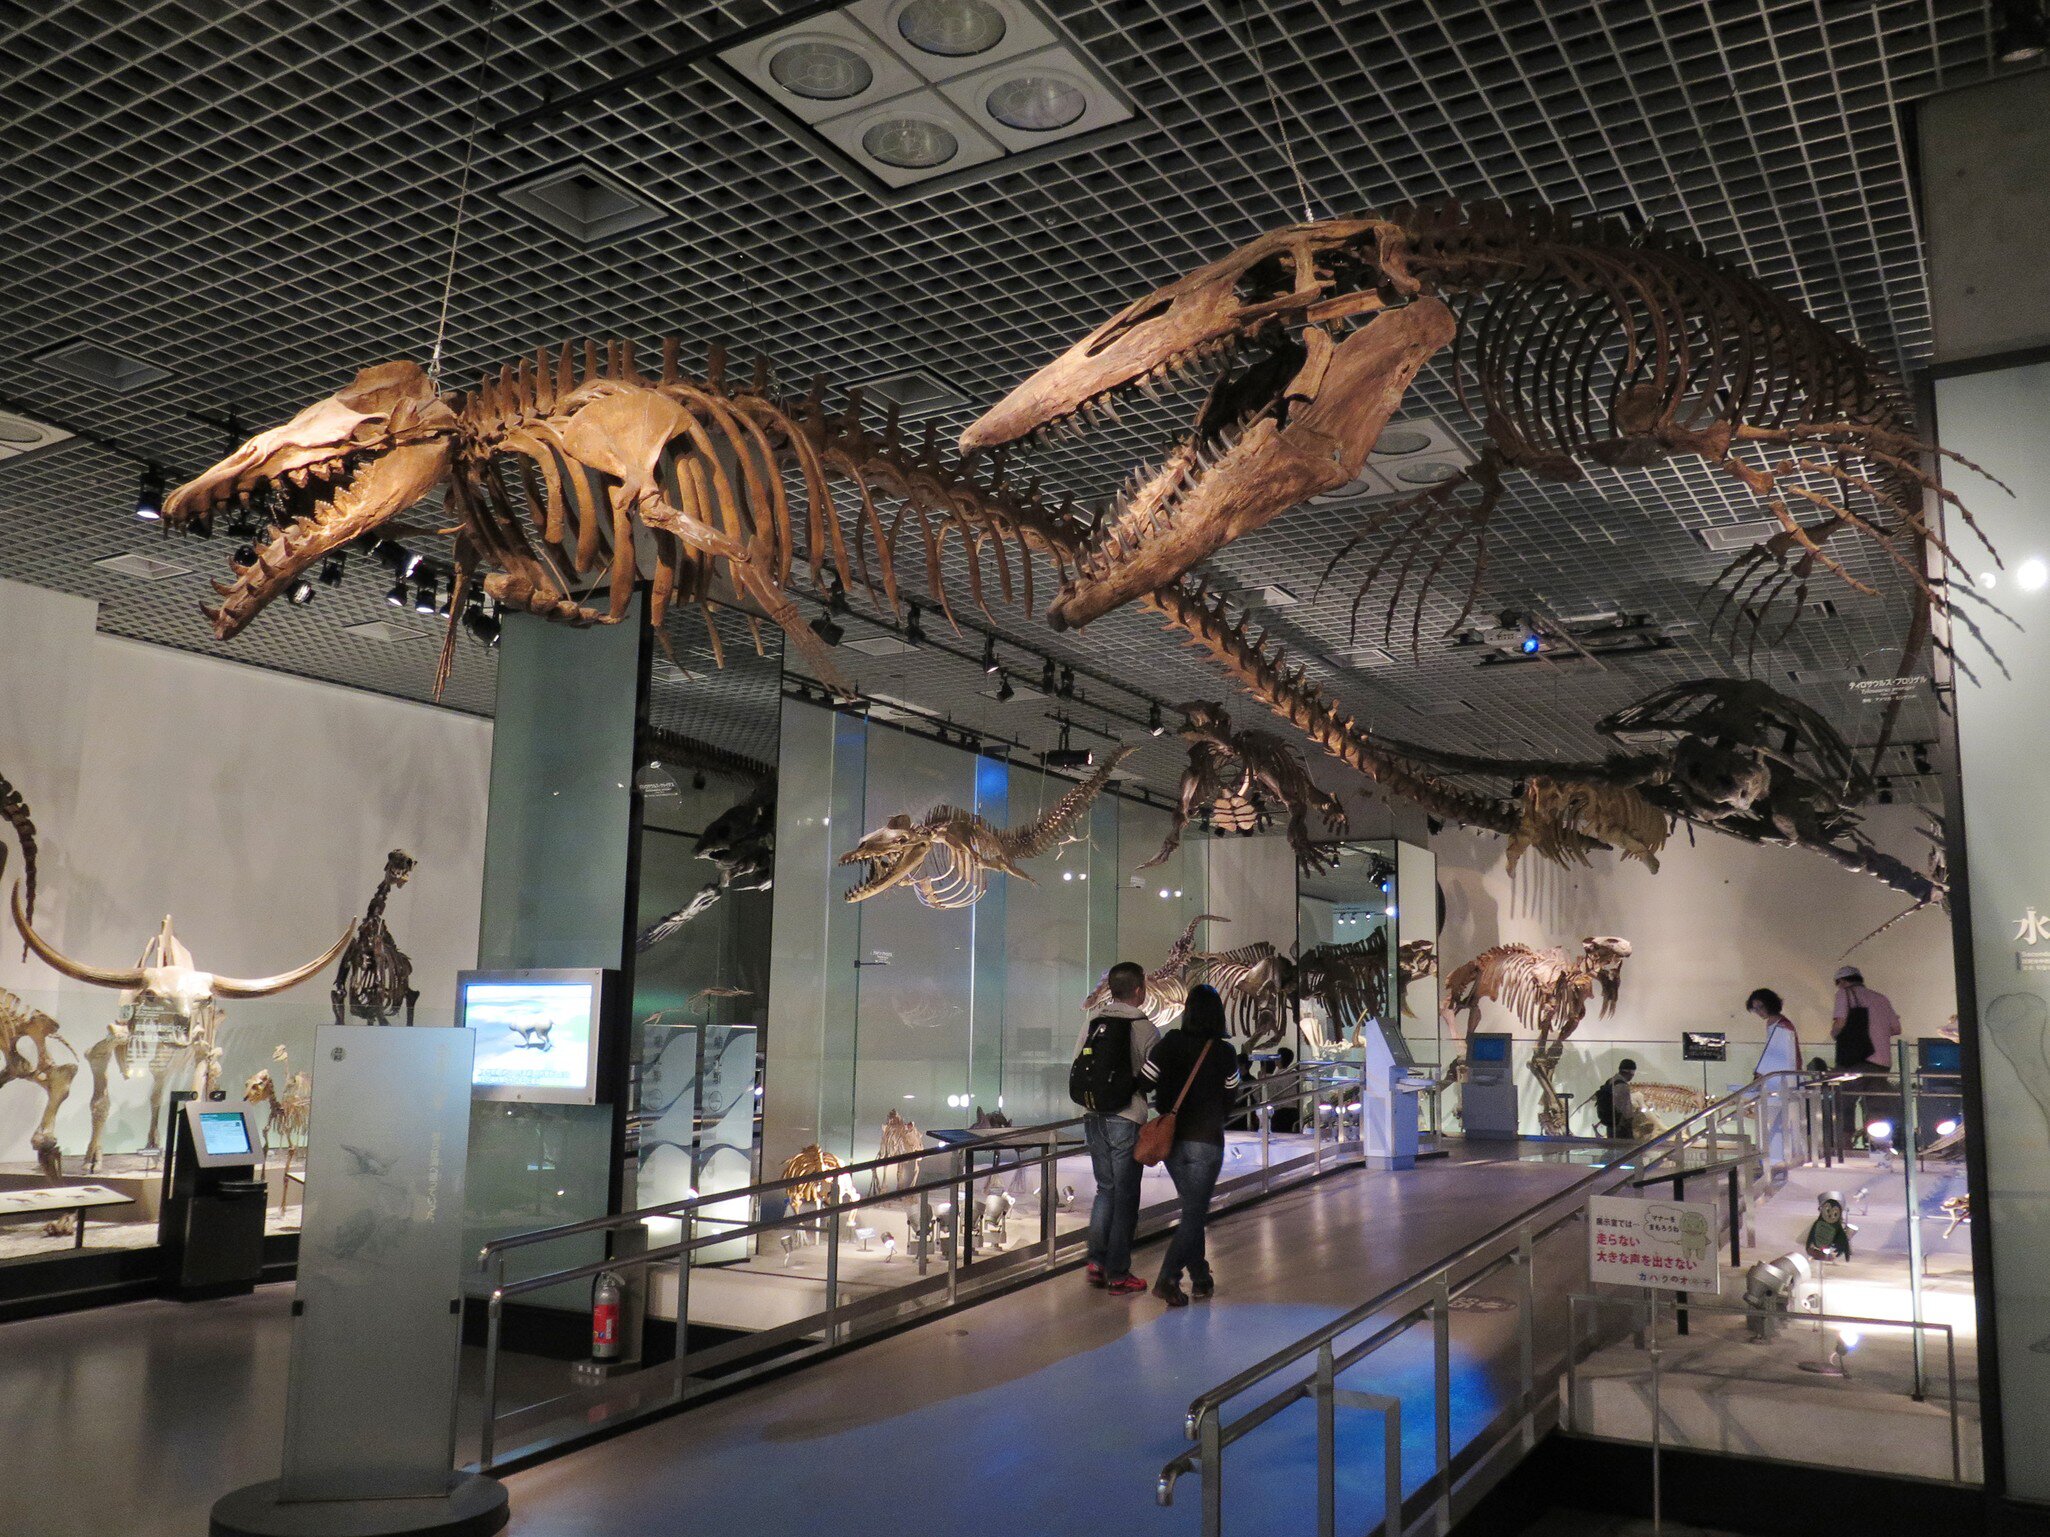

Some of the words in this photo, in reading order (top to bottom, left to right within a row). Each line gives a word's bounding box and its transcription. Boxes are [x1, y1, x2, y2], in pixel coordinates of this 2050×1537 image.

[1596, 1232, 1640, 1247] 走らない
[1596, 1250, 1698, 1270] 大きな声を出さない
